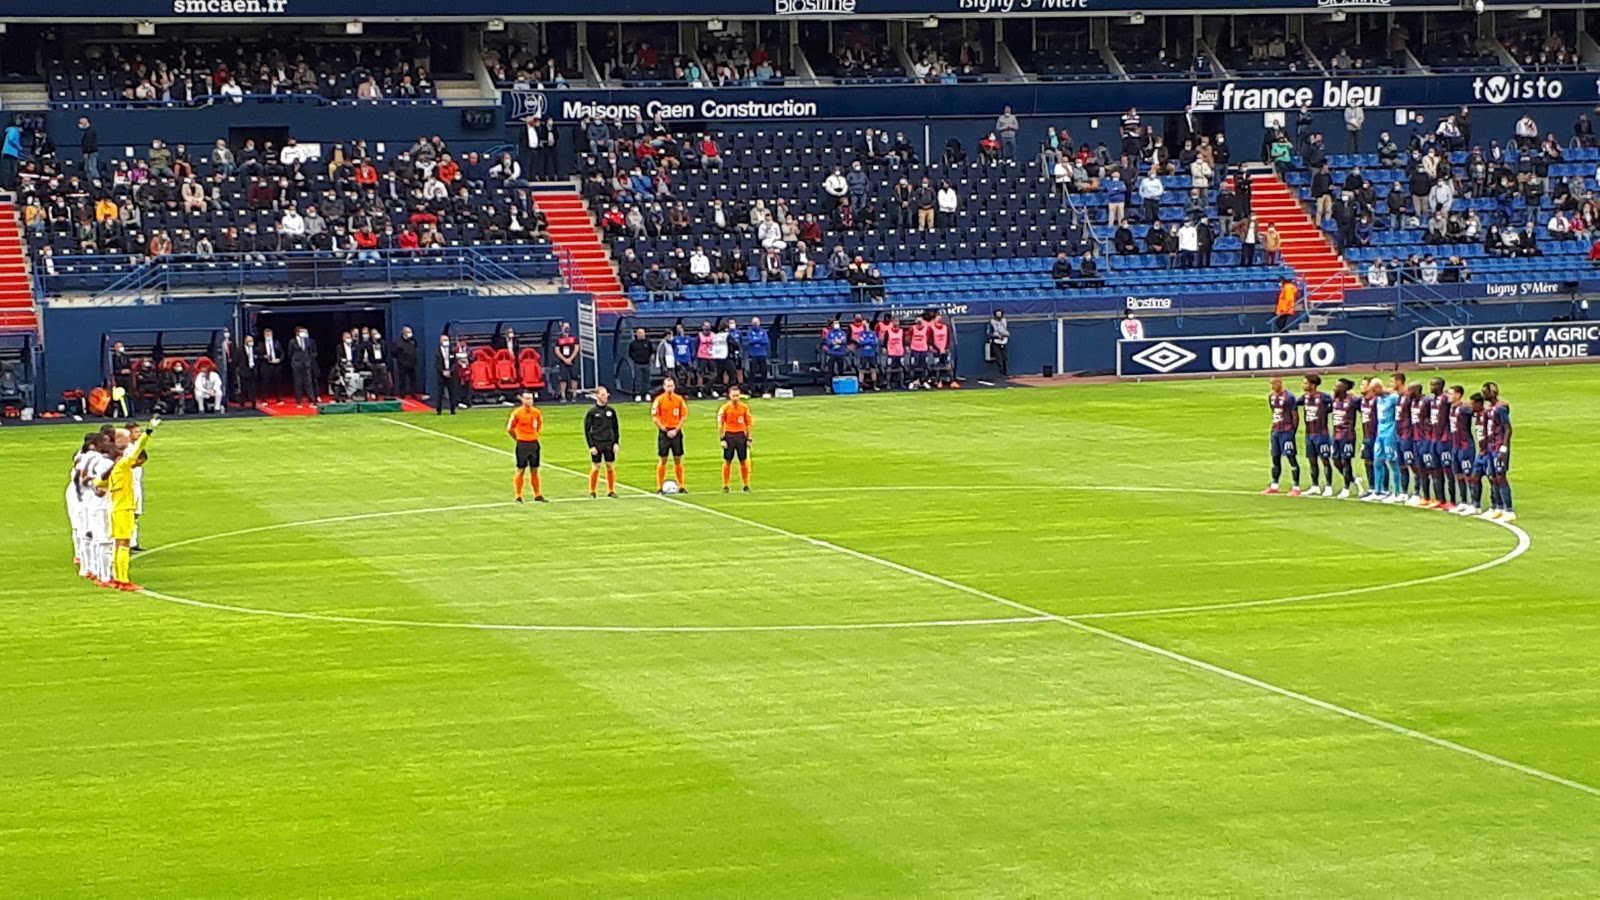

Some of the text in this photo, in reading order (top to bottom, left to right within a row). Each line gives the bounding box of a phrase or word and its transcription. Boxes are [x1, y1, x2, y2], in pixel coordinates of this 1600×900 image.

[173, 0, 288, 13] smcaen.fr
[1222, 80, 1381, 110] france bleu
[1472, 74, 1562, 104] twisto
[563, 98, 817, 119] Maisons Caen Construction
[1471, 326, 1600, 344] CRÉDIT AGRIC
[1211, 337, 1335, 371] umbro
[1472, 343, 1589, 360] NORMANDIE
